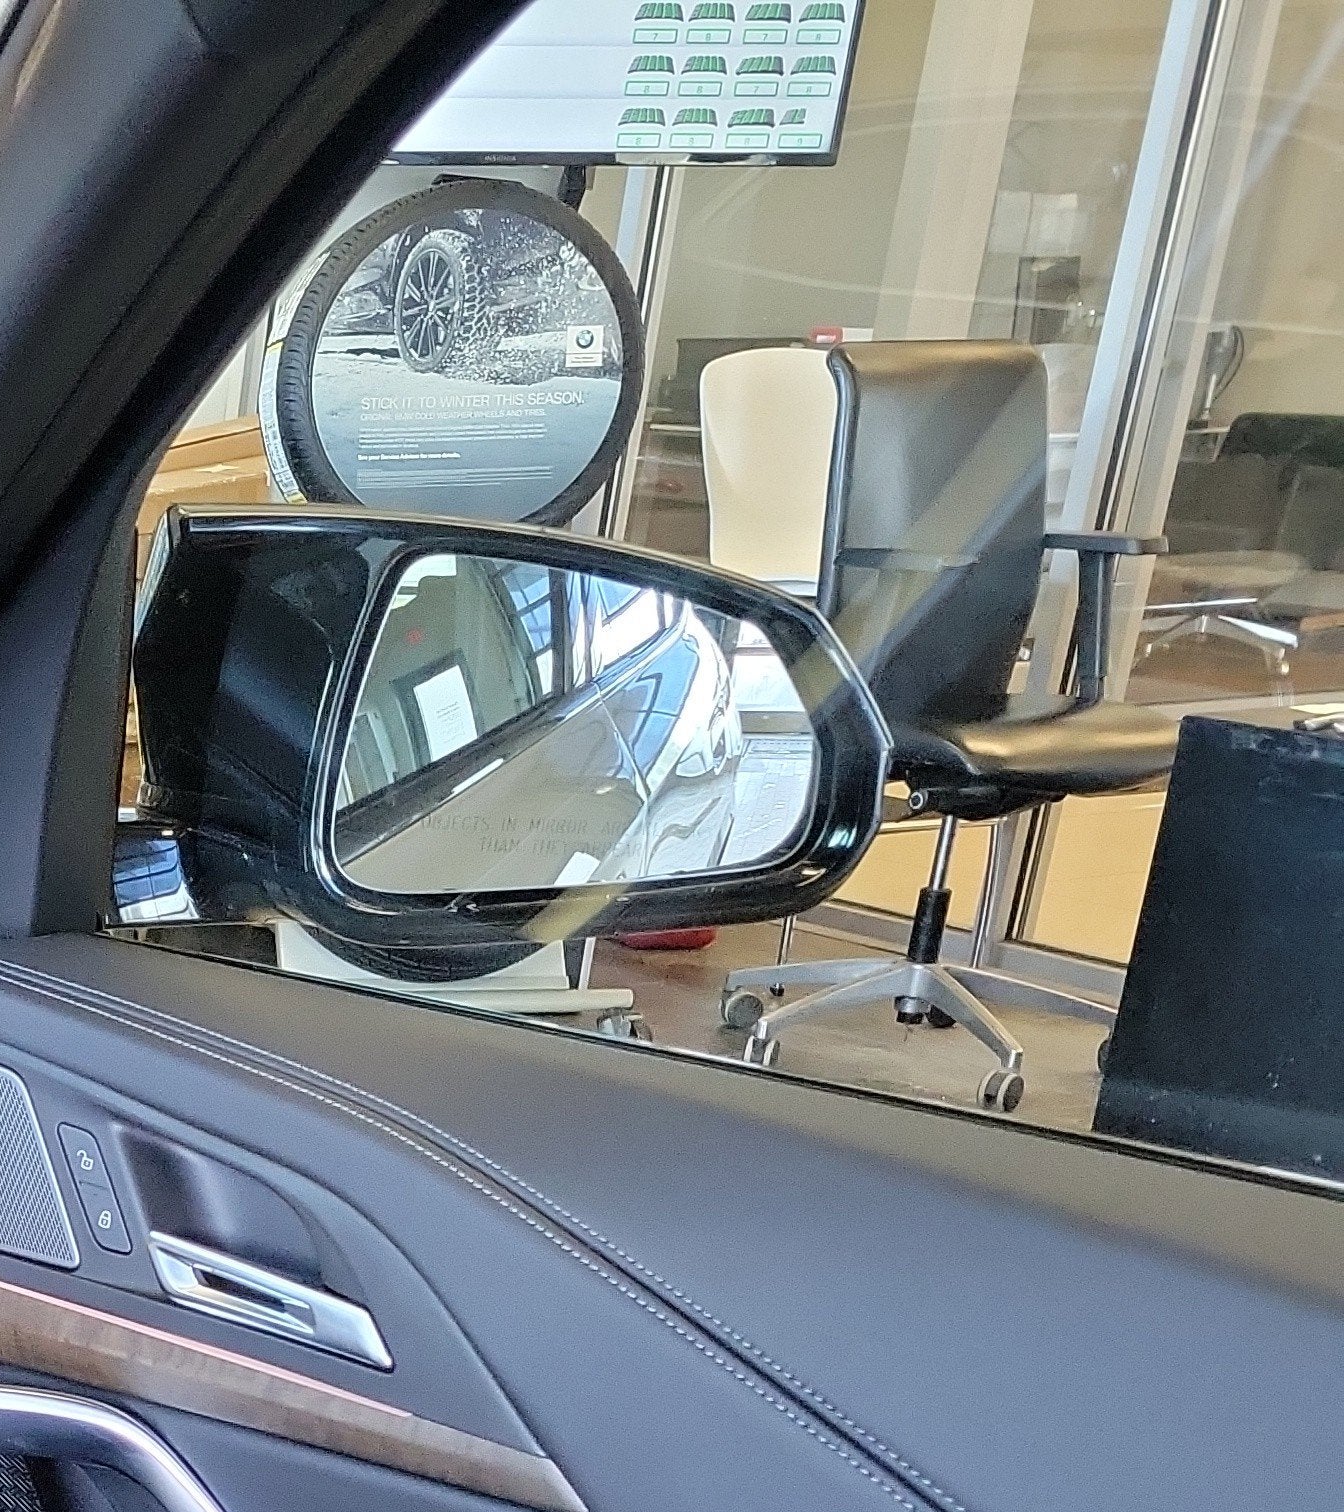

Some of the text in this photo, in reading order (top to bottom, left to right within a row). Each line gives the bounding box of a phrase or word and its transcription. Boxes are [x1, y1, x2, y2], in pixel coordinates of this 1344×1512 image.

[361, 390, 585, 410] STICK IT TO WINTER THIS SEASON.
